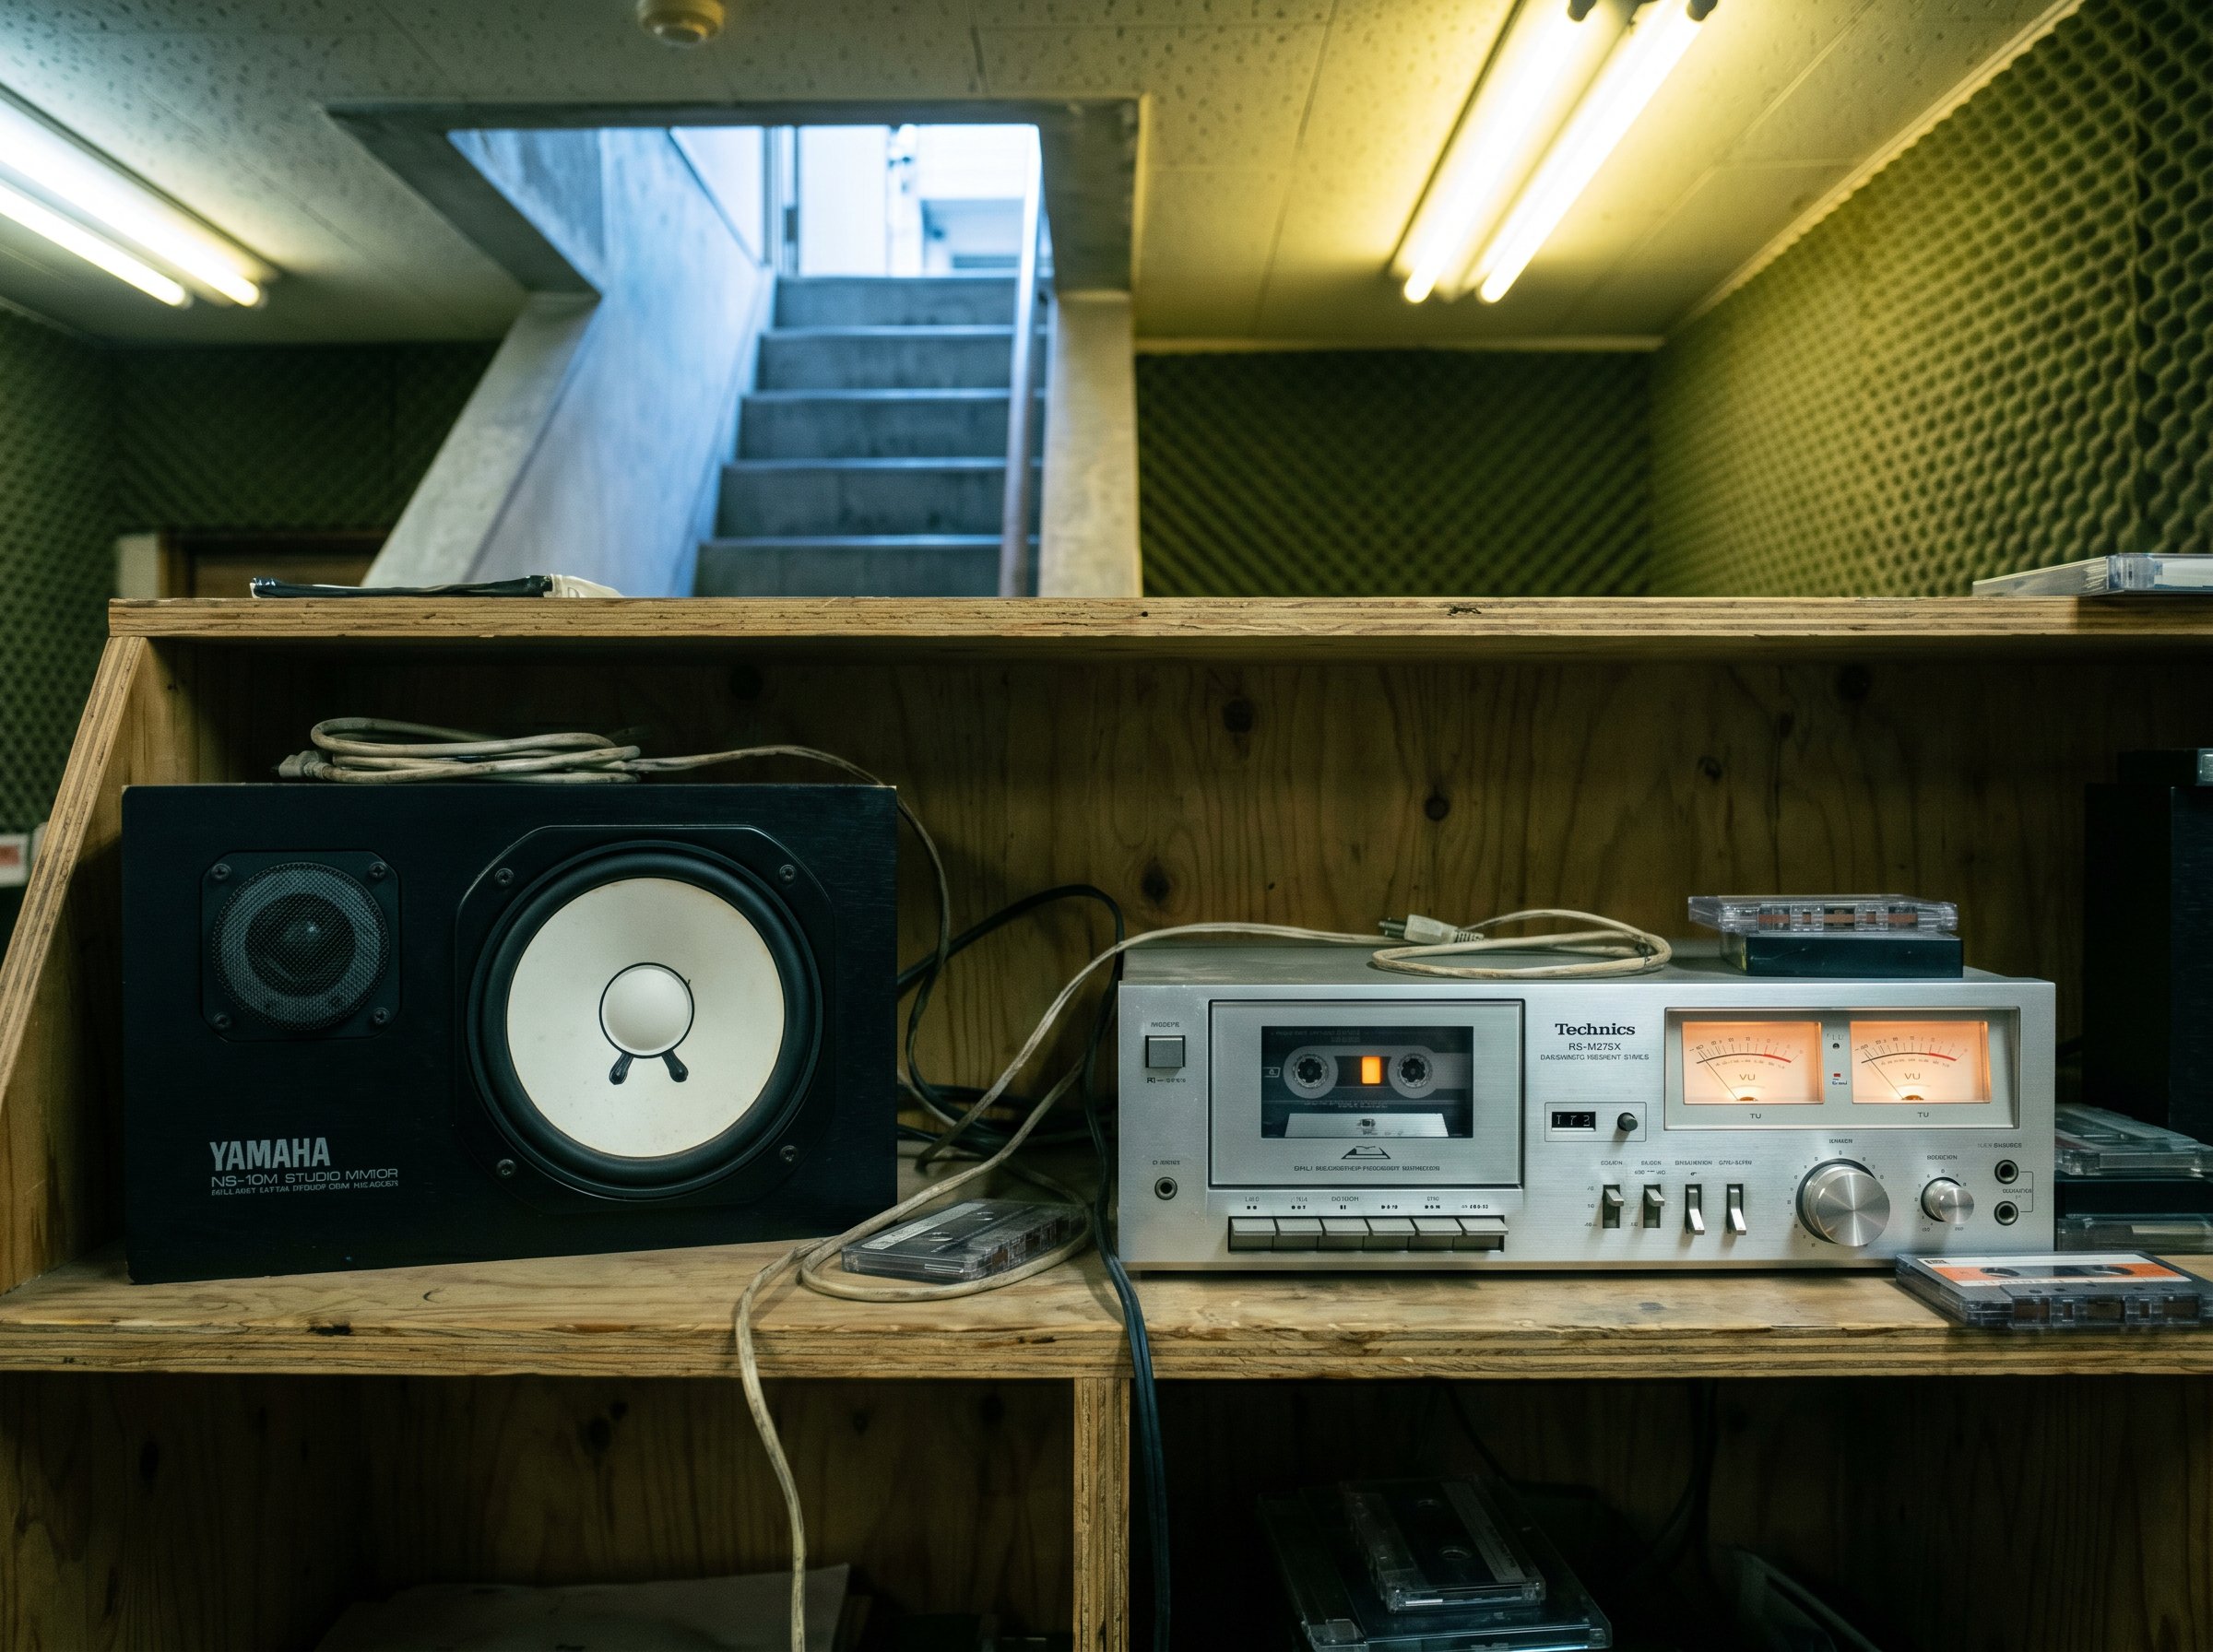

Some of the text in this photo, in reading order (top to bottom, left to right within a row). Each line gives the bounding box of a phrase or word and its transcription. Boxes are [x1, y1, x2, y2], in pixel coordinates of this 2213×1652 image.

[1555, 1022, 1636, 1035] Technics
[1739, 1073, 1756, 1081] VU
[1904, 1072, 1921, 1080] VU
[209, 1137, 331, 1172] YAMAHA
[211, 1173, 278, 1187] NS-10M
[285, 1171, 341, 1184] STUDIO
